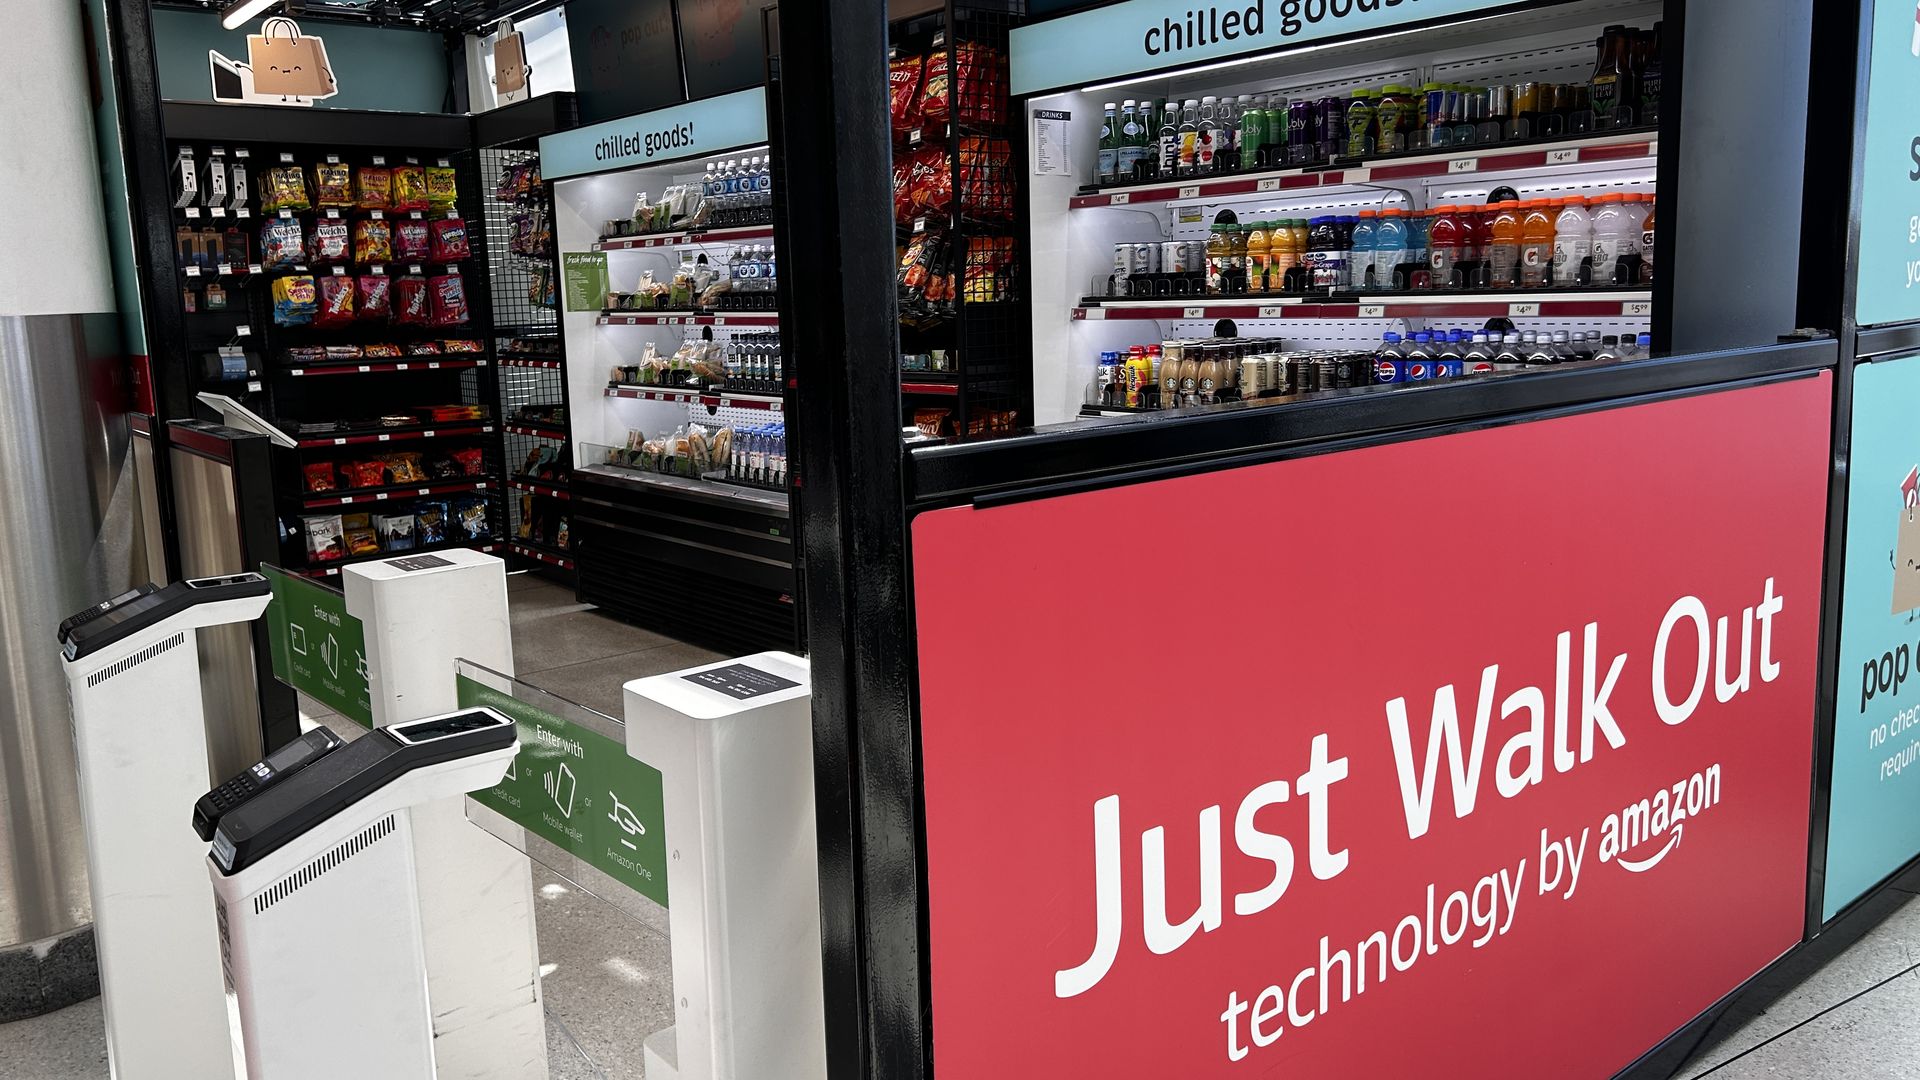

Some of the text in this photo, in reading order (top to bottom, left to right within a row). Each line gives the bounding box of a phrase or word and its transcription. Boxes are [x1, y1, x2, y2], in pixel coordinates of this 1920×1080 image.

[1144, 0, 1420, 56] chilled goo
[1041, 111, 1063, 119] DRINKS
[595, 122, 694, 161] chilled goods!
[1163, 137, 1175, 169] hint
[320, 168, 347, 177] HARIBO
[274, 226, 301, 238] Welch's
[319, 225, 346, 236] Welch's
[1524, 247, 1539, 266] G
[1129, 365, 1137, 392] Nesquik
[312, 527, 331, 537] bark
[313, 604, 341, 628] Enter with
[1860, 643, 1910, 714] pop
[536, 723, 584, 759] Enter with
[1870, 723, 1887, 750] no
[491, 785, 521, 809] Credit card
[1054, 577, 1785, 999] Just Walk Out
[542, 811, 584, 844] Mobile wallet
[606, 847, 653, 881] Amazon One
[1220, 761, 1722, 1063] technology by amazon
